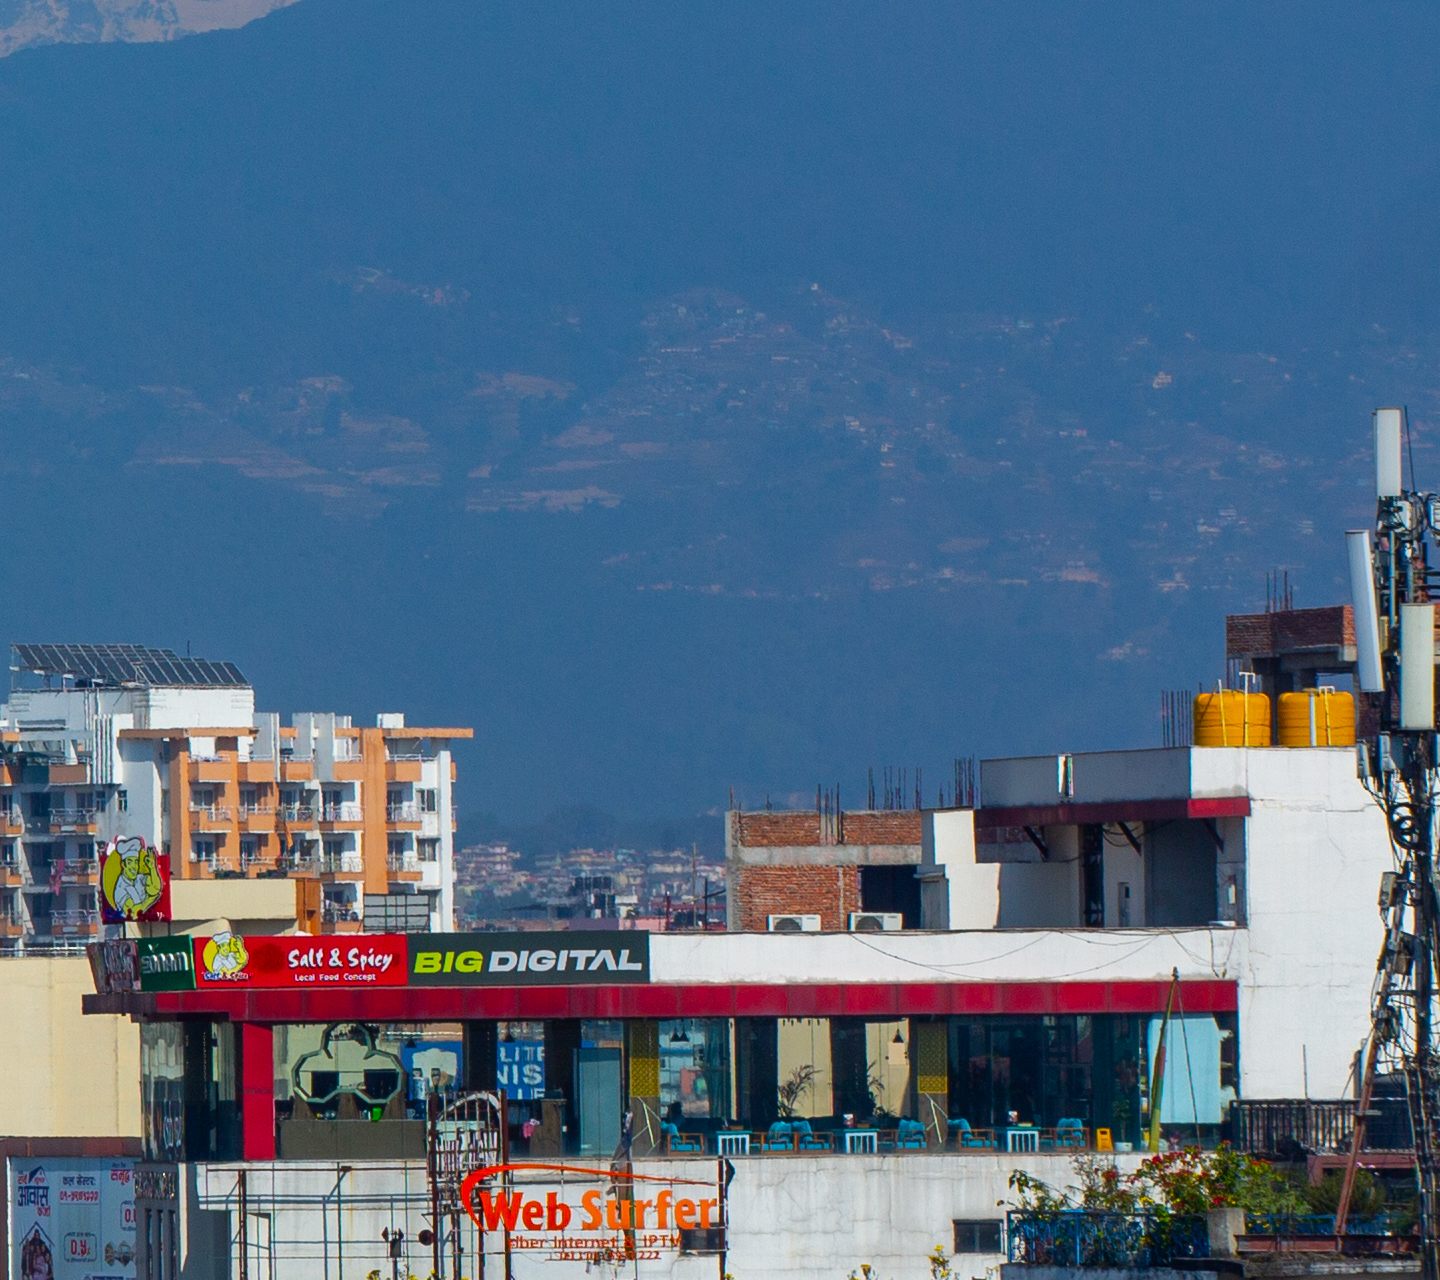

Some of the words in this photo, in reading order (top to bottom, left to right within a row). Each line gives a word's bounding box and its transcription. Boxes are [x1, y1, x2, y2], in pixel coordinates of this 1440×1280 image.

[288, 948, 323, 968] Salt
[329, 948, 343, 967] &
[348, 948, 393, 972] Spicy
[414, 951, 483, 973] BIG
[488, 949, 642, 972] DIGITAL
[294, 973, 315, 982] Local
[319, 973, 339, 981] Food
[343, 973, 376, 983] Concept
[479, 1191, 572, 1231] Web
[582, 1190, 717, 1231] Surfer
[553, 1235, 617, 1249] Internet
[643, 1233, 682, 1248] IPTV
